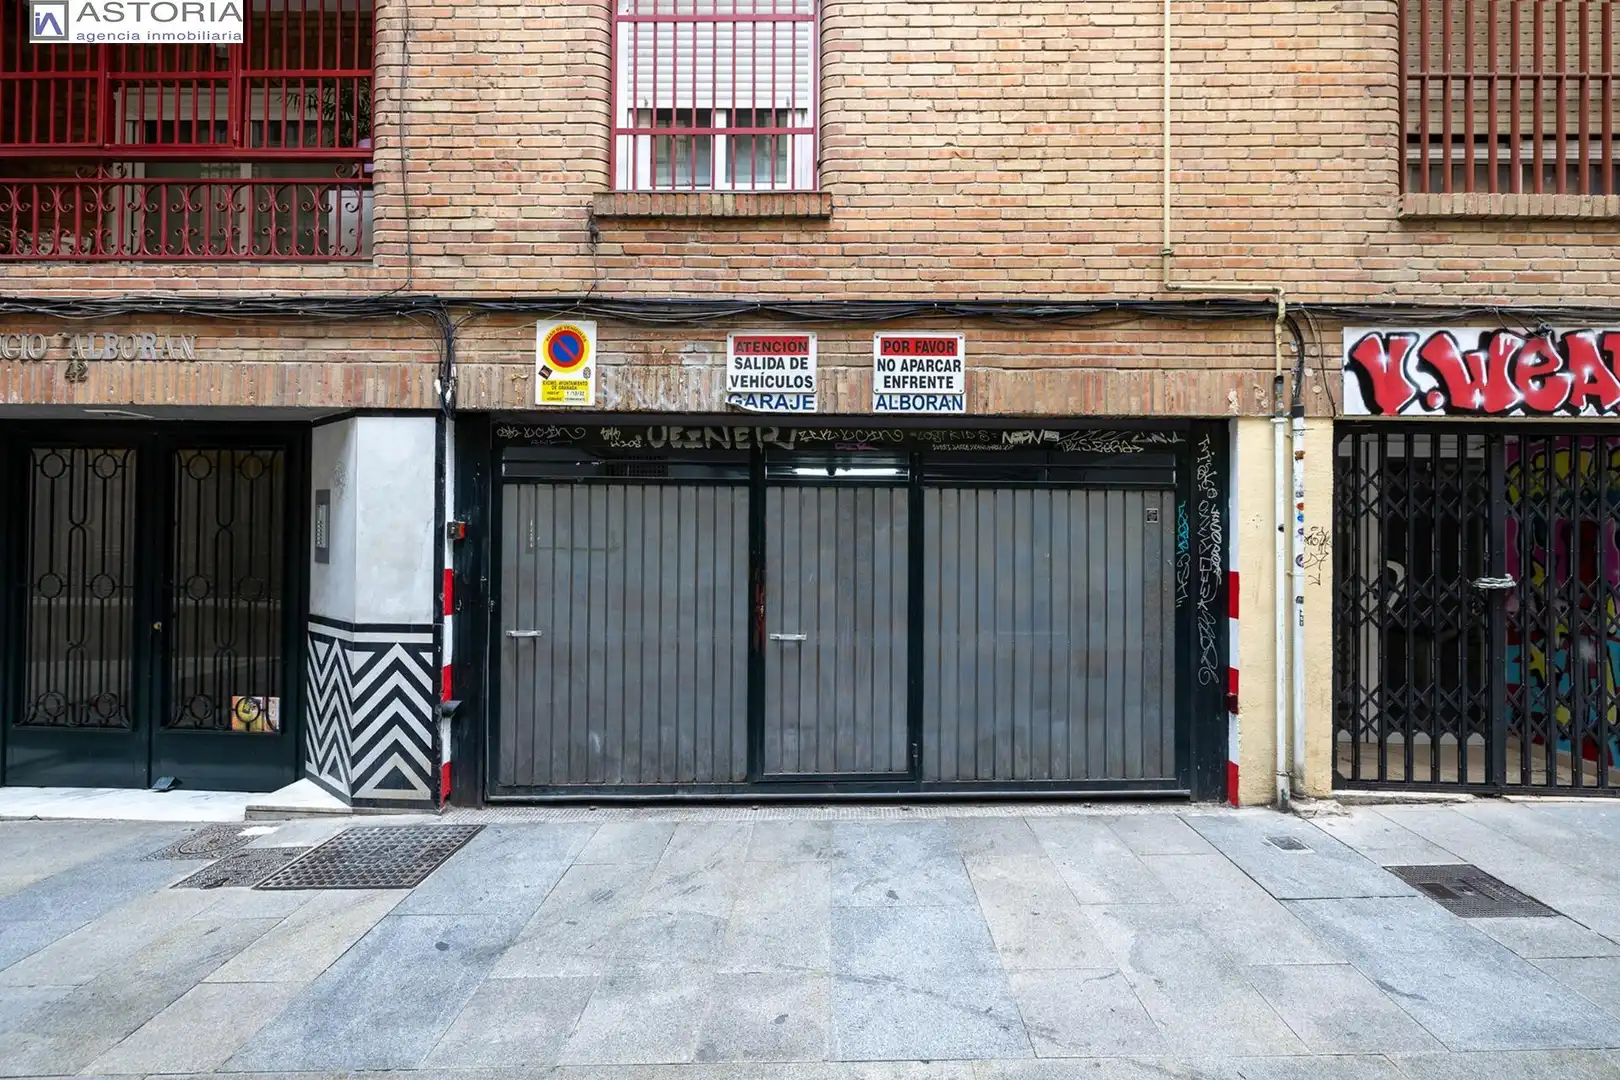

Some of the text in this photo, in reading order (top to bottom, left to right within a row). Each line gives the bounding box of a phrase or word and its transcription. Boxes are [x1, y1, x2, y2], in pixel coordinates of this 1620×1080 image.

[0, 331, 198, 361] CIO ALBORAN
[883, 340, 955, 353] POR FAVOR
[734, 356, 809, 370] SALIDA DE
[877, 358, 962, 373] NO APARCAR
[64, 361, 88, 383] 42
[730, 371, 813, 389] VEHÍCULOS
[883, 375, 954, 389] ENFRENTE
[728, 393, 815, 410] GARAJE
[875, 394, 963, 411] ALBORAN
